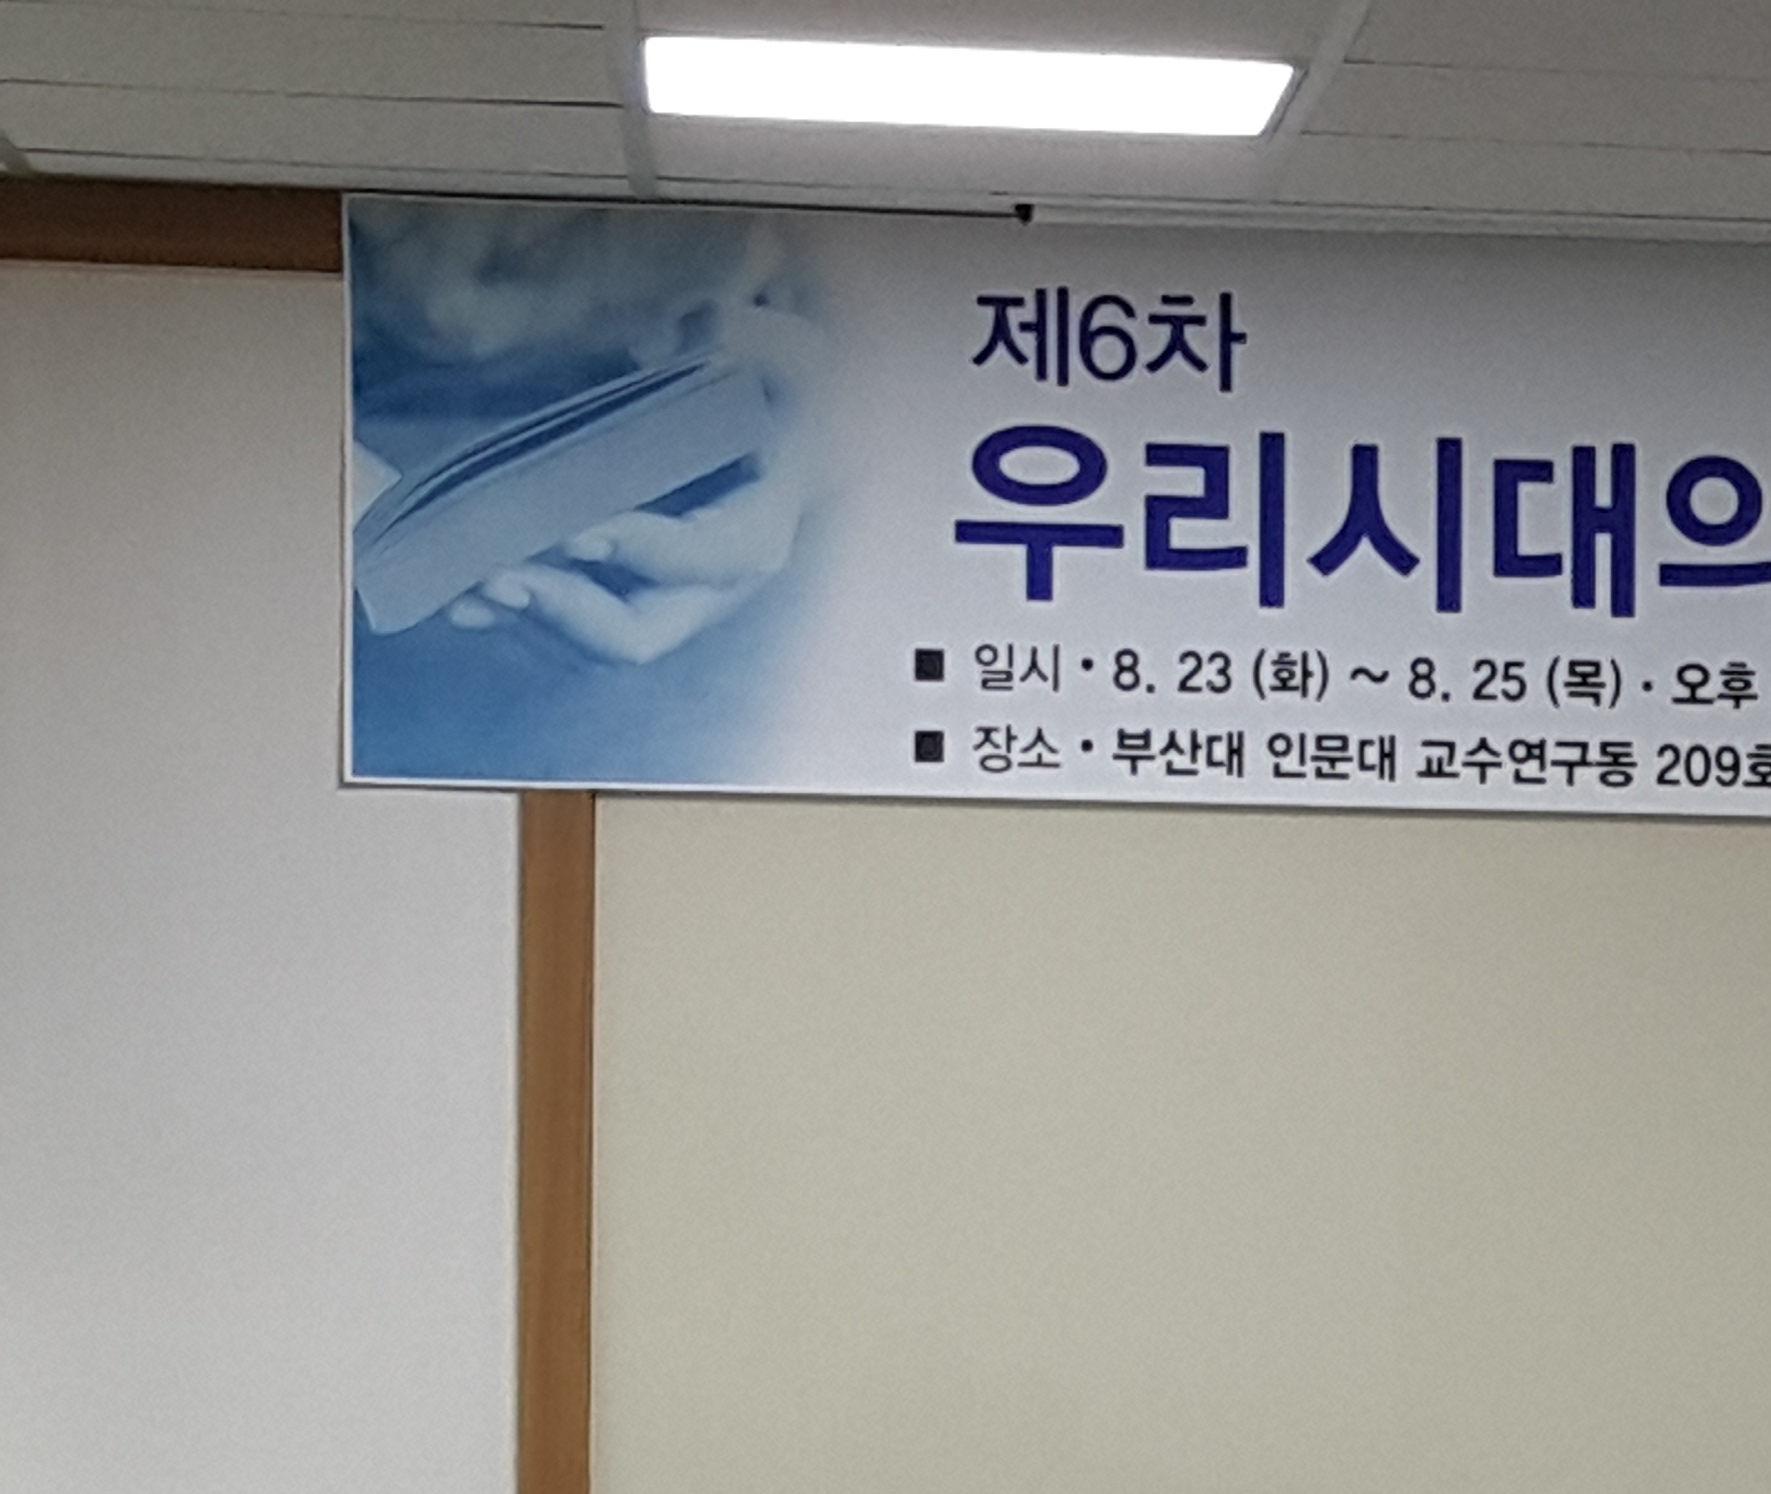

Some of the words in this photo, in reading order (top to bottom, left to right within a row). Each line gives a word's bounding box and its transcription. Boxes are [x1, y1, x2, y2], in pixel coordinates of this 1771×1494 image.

[972, 286, 1247, 393] 제6차
[975, 644, 1059, 691] 일시
[1178, 651, 1232, 693] 23
[1253, 649, 1329, 701] (화)
[1473, 659, 1526, 702] 25
[1547, 656, 1621, 708] (목)
[1672, 662, 1758, 709] 오후
[974, 725, 1060, 773] 장소
[1113, 729, 1244, 778] 부산대
[1267, 733, 1395, 782] 인문대
[1417, 737, 1637, 788] 교수연구동
